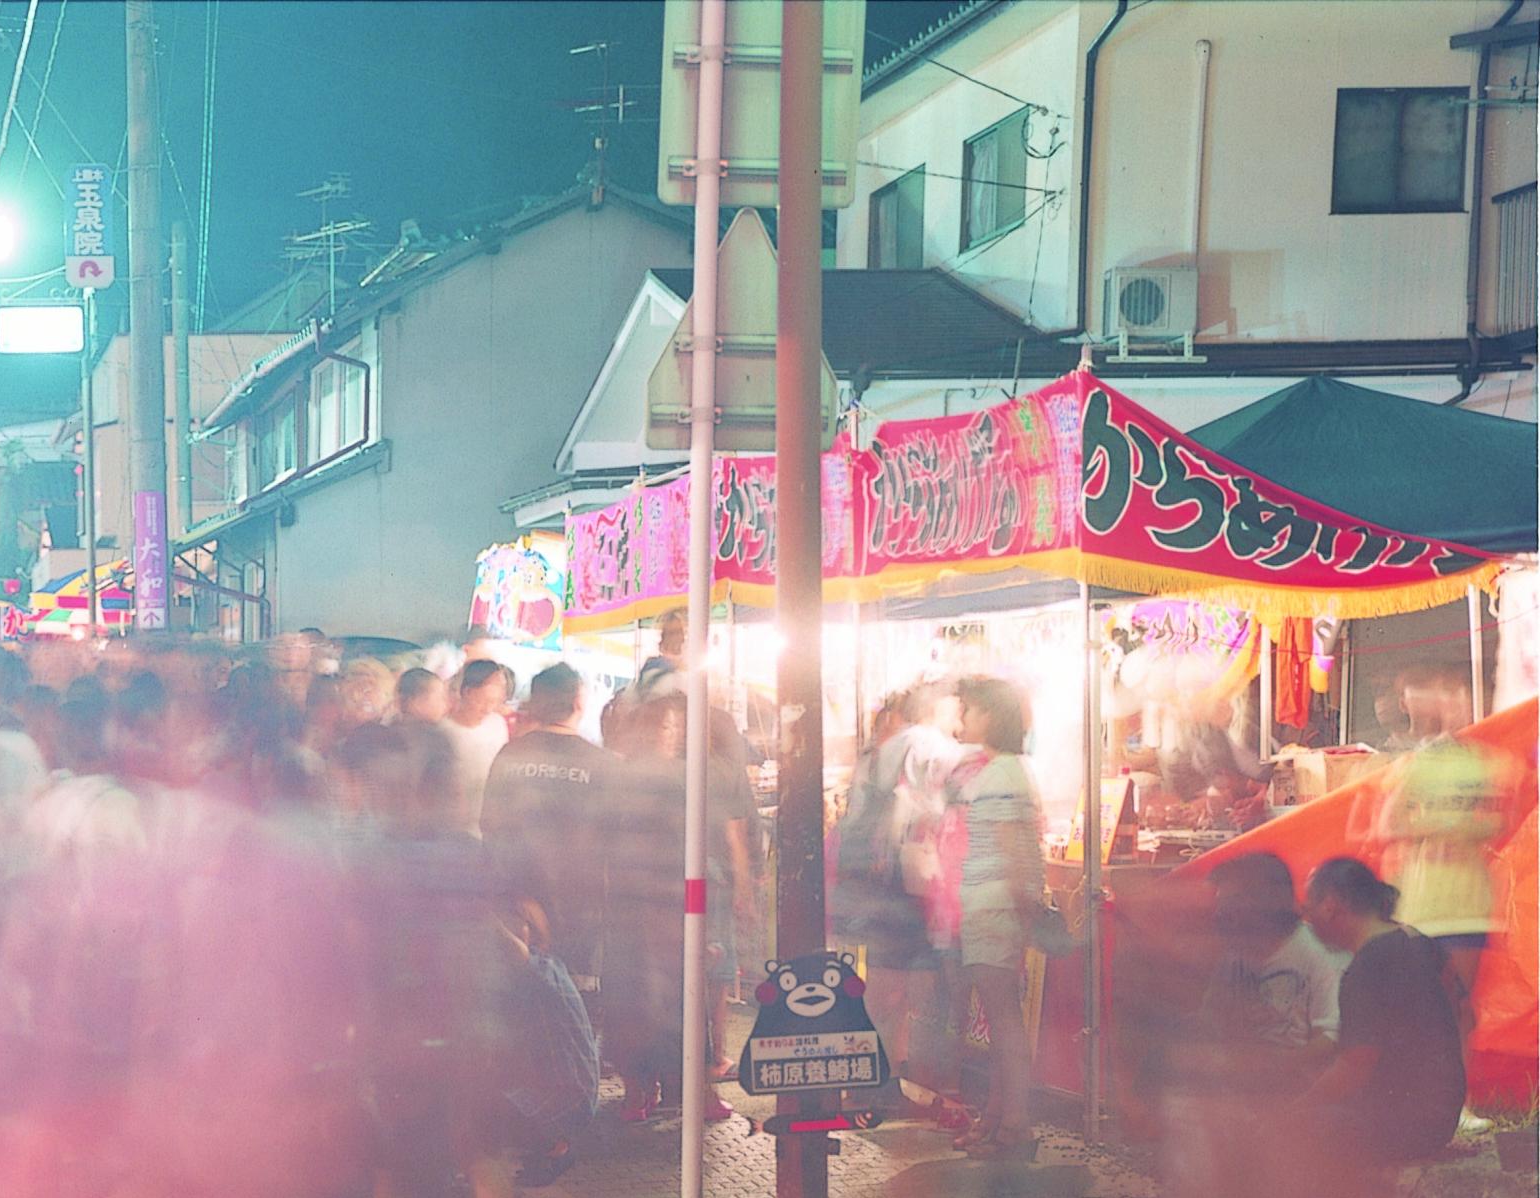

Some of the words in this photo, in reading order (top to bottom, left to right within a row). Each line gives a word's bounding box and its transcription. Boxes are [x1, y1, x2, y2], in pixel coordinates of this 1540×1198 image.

[73, 183, 105, 255] 玉泉院
[141, 538, 162, 598] 大和
[760, 1056, 873, 1088] 柿原養鱒場
